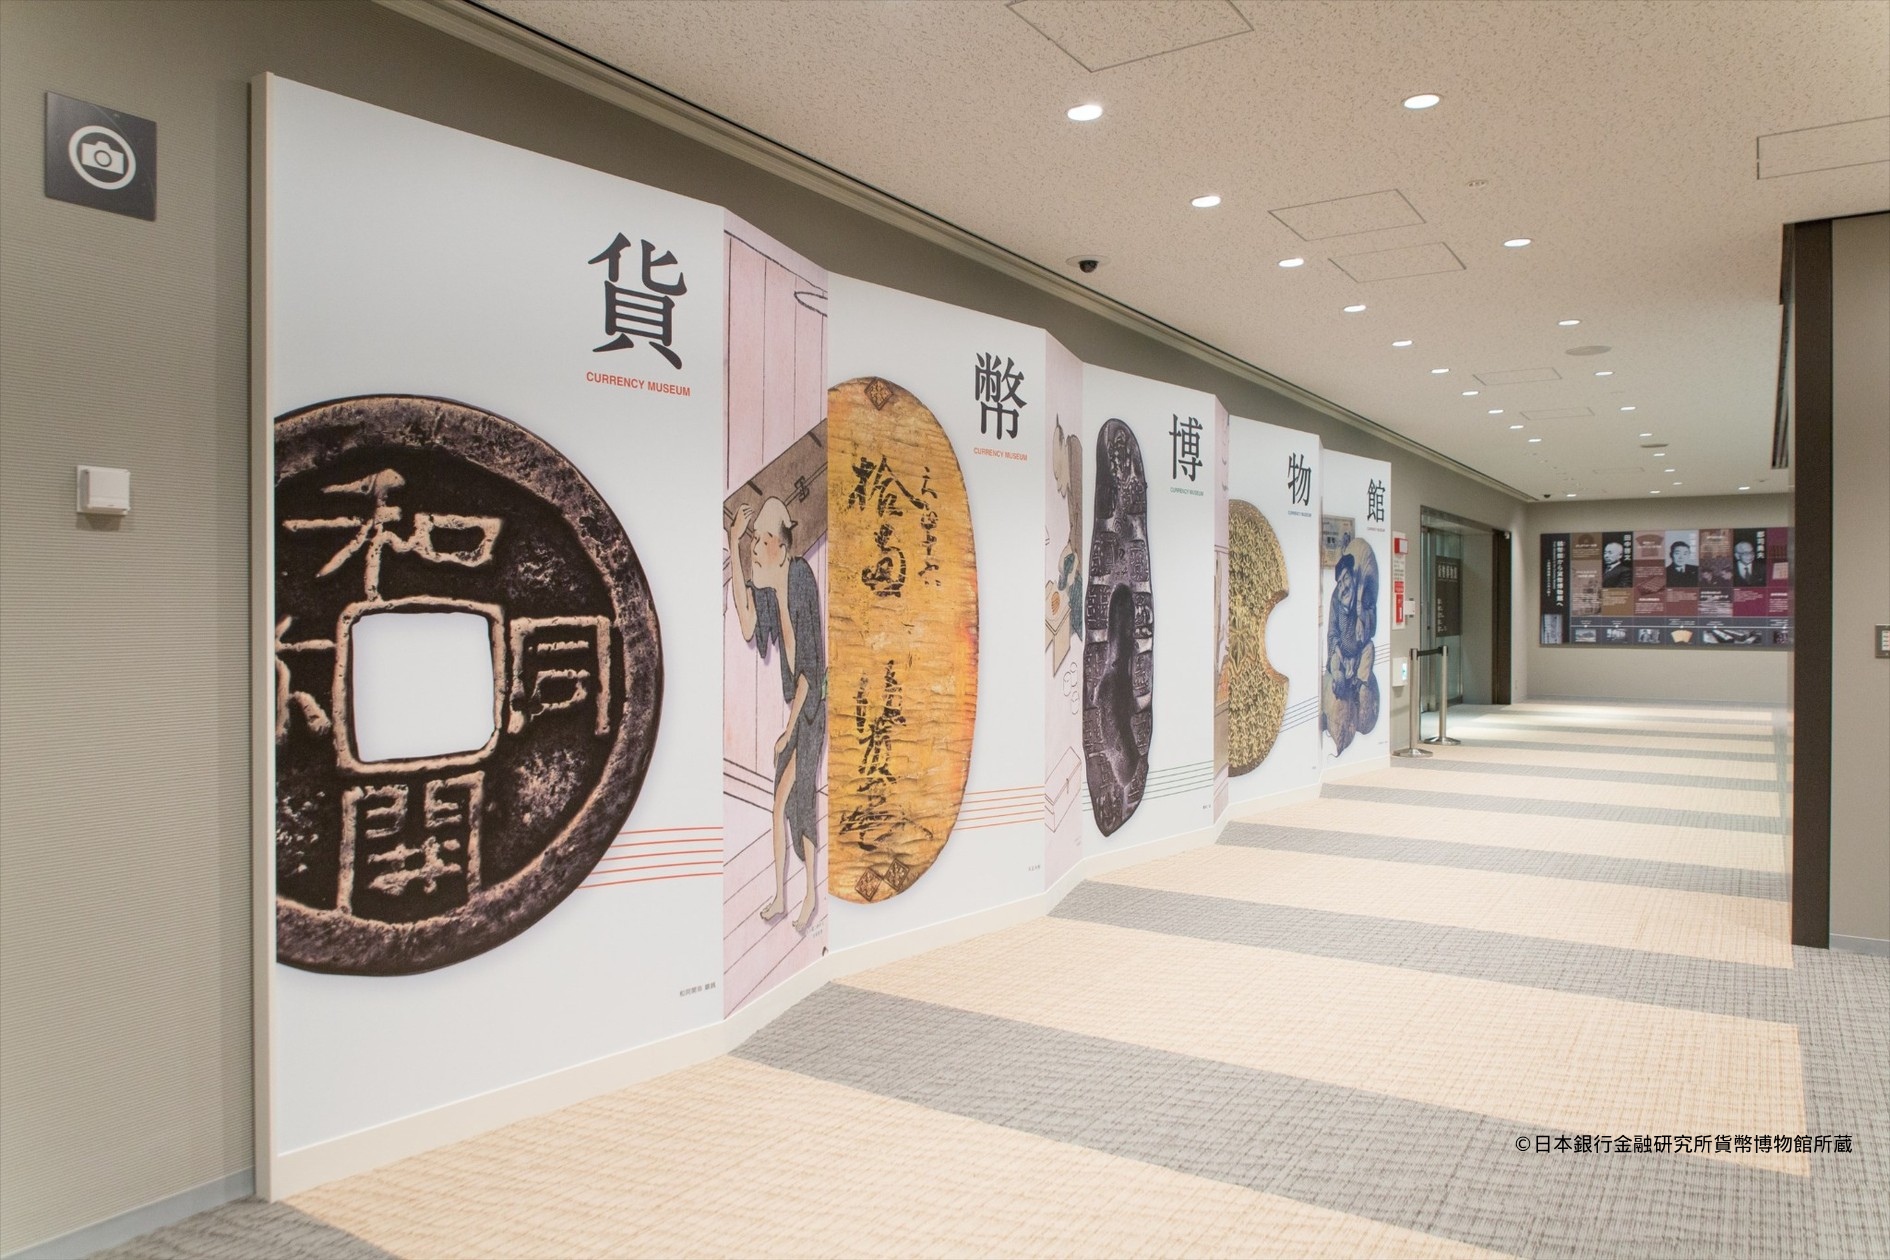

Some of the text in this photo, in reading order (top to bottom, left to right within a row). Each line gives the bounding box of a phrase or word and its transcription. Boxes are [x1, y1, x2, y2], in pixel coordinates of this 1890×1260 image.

[588, 232, 687, 370] 貨
[586, 371, 691, 397] CURRENCY MUSEUM
[974, 351, 1028, 440] 幣
[973, 447, 1028, 461] CURRENCY MUSEUM
[1169, 413, 1203, 482] 博
[1287, 452, 1312, 506] 物
[1366, 478, 1386, 523] 館
